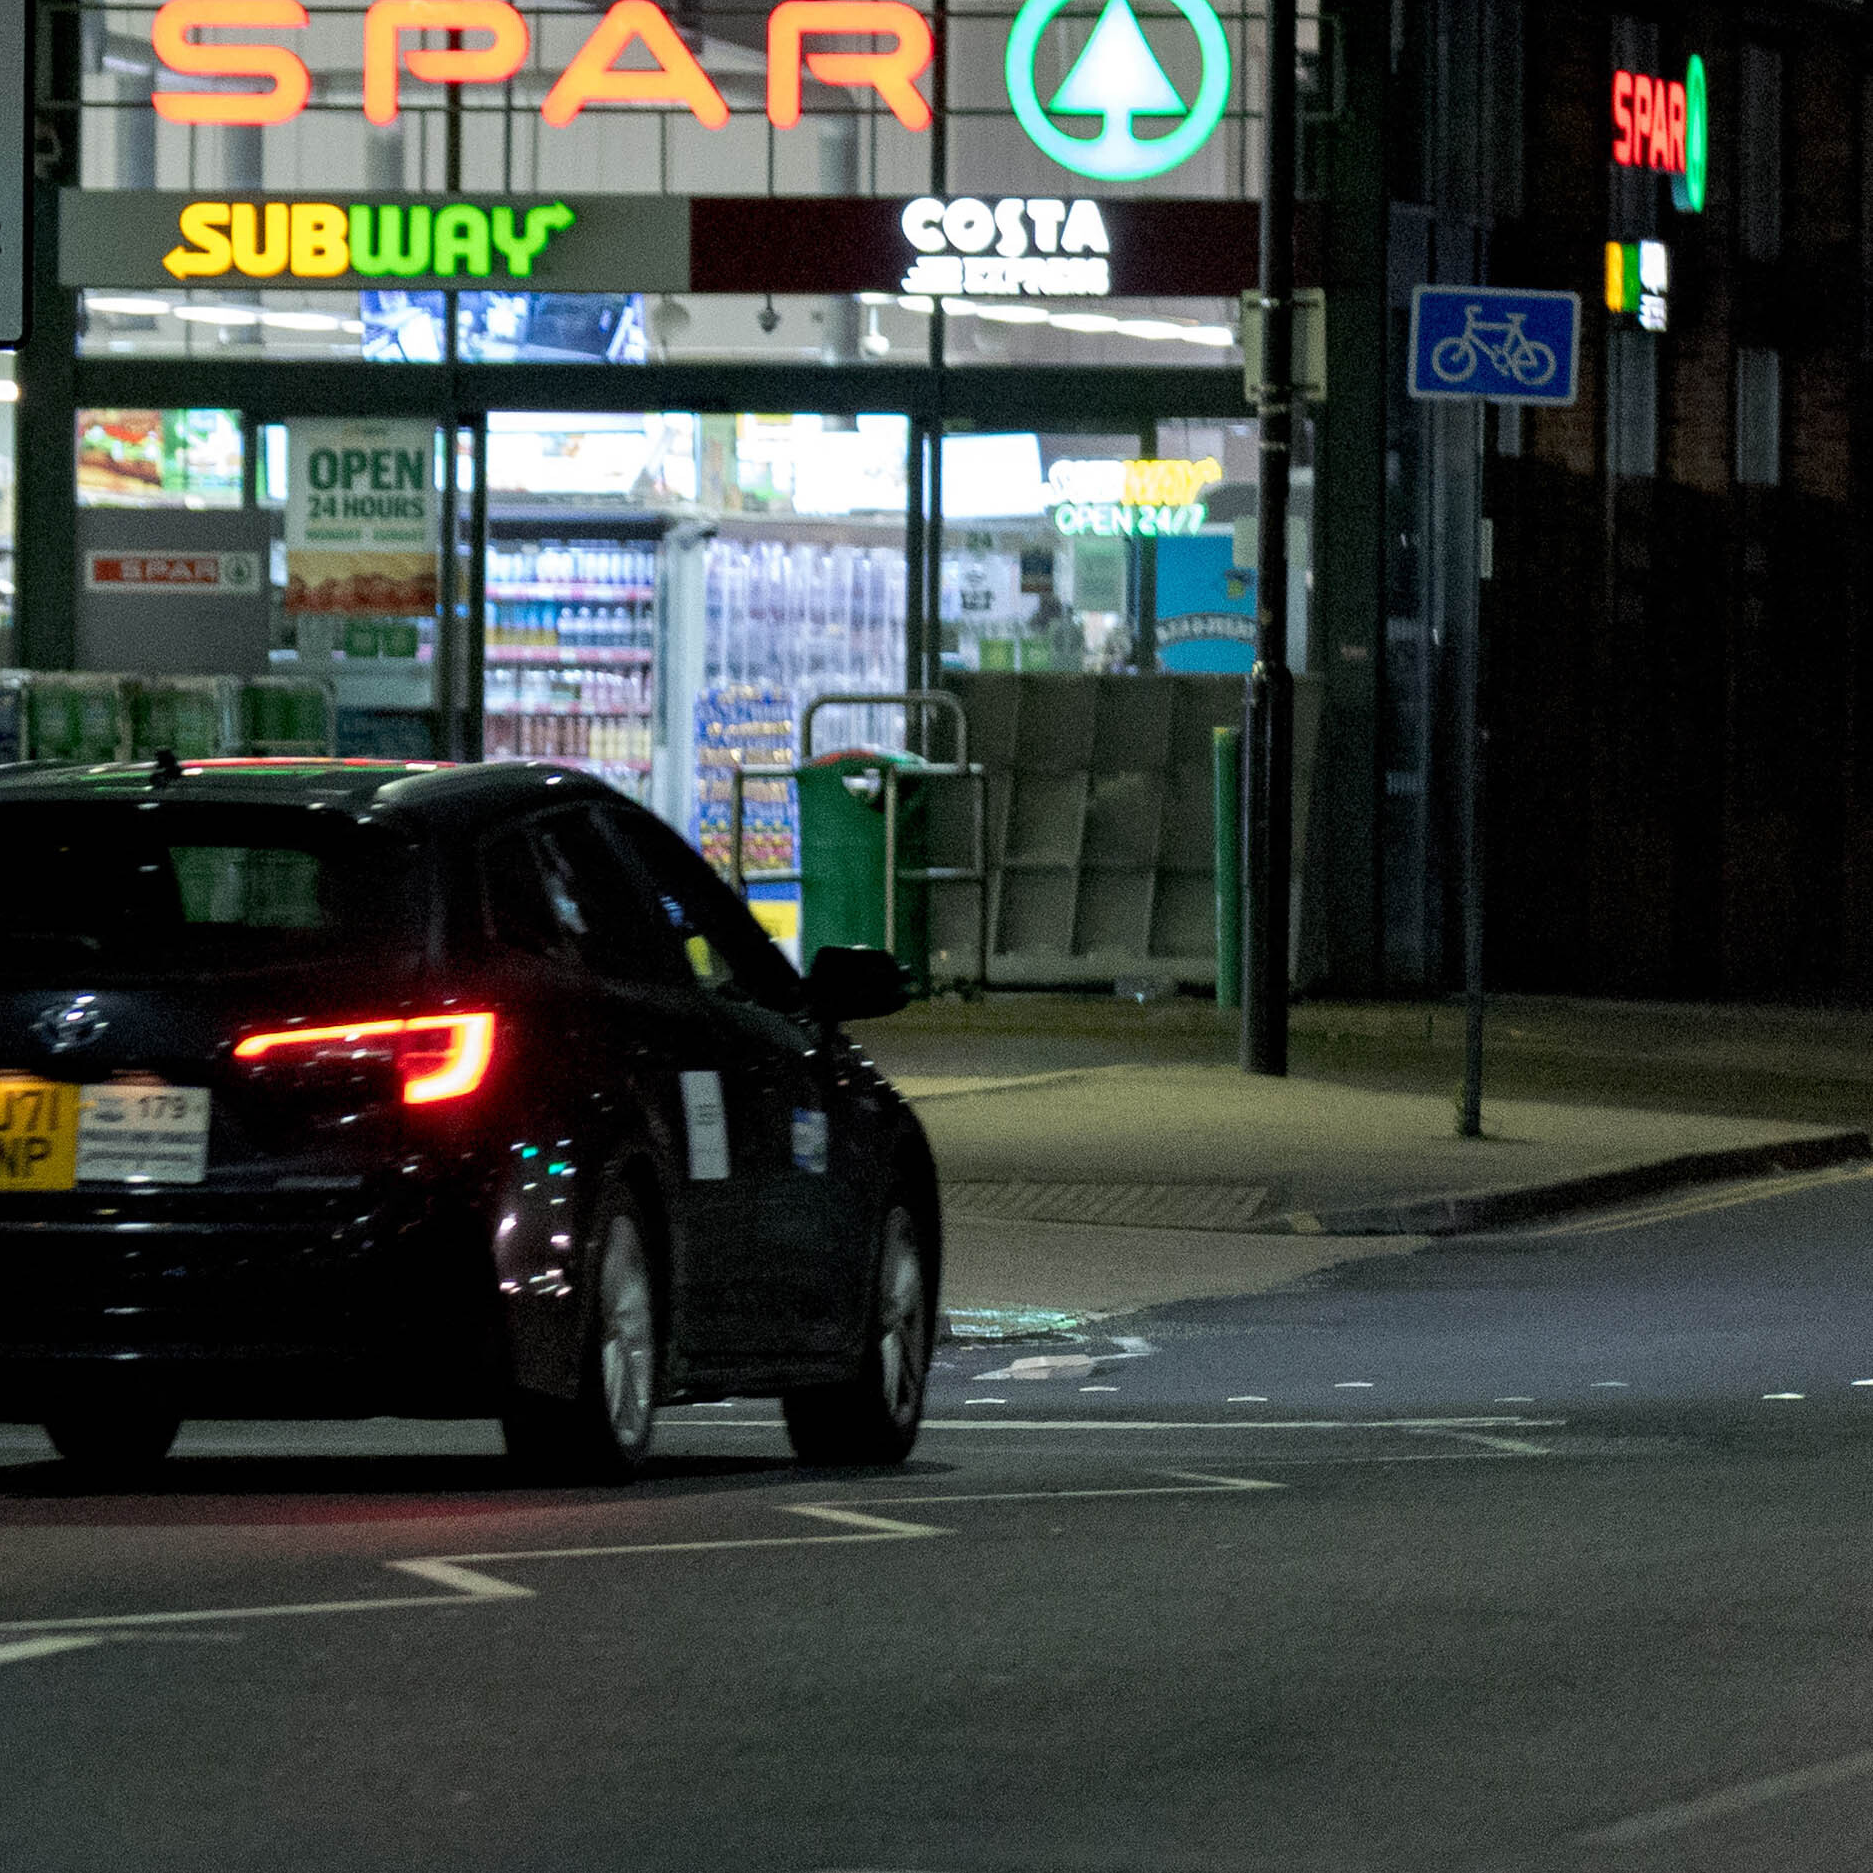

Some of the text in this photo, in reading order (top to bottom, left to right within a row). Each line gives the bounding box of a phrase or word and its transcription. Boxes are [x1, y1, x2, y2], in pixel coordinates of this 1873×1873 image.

[1612, 68, 1688, 175] SPAR
[162, 200, 577, 282] SUBWAY
[901, 197, 1110, 258] COSTA
[307, 446, 426, 492] OPEN
[307, 493, 426, 521] 24 HOURS
[1054, 503, 1134, 537] OPEN
[119, 557, 219, 583] SPAR
